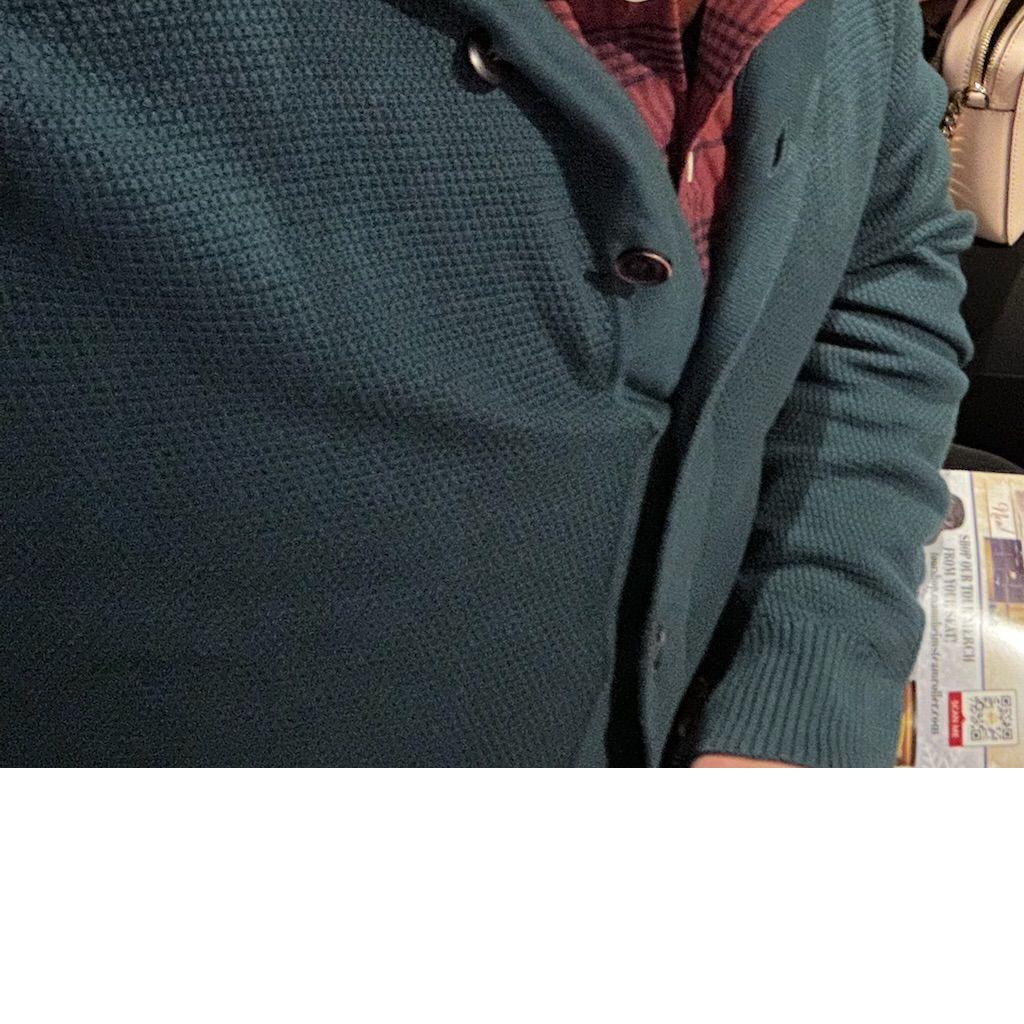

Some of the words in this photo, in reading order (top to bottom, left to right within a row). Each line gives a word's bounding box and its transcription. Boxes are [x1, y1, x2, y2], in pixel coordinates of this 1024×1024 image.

[960, 534, 972, 559] SHOP
[943, 547, 956, 576] FROM
[960, 561, 973, 582] OUR
[951, 699, 961, 723] SCAN
[951, 725, 961, 739] ME
